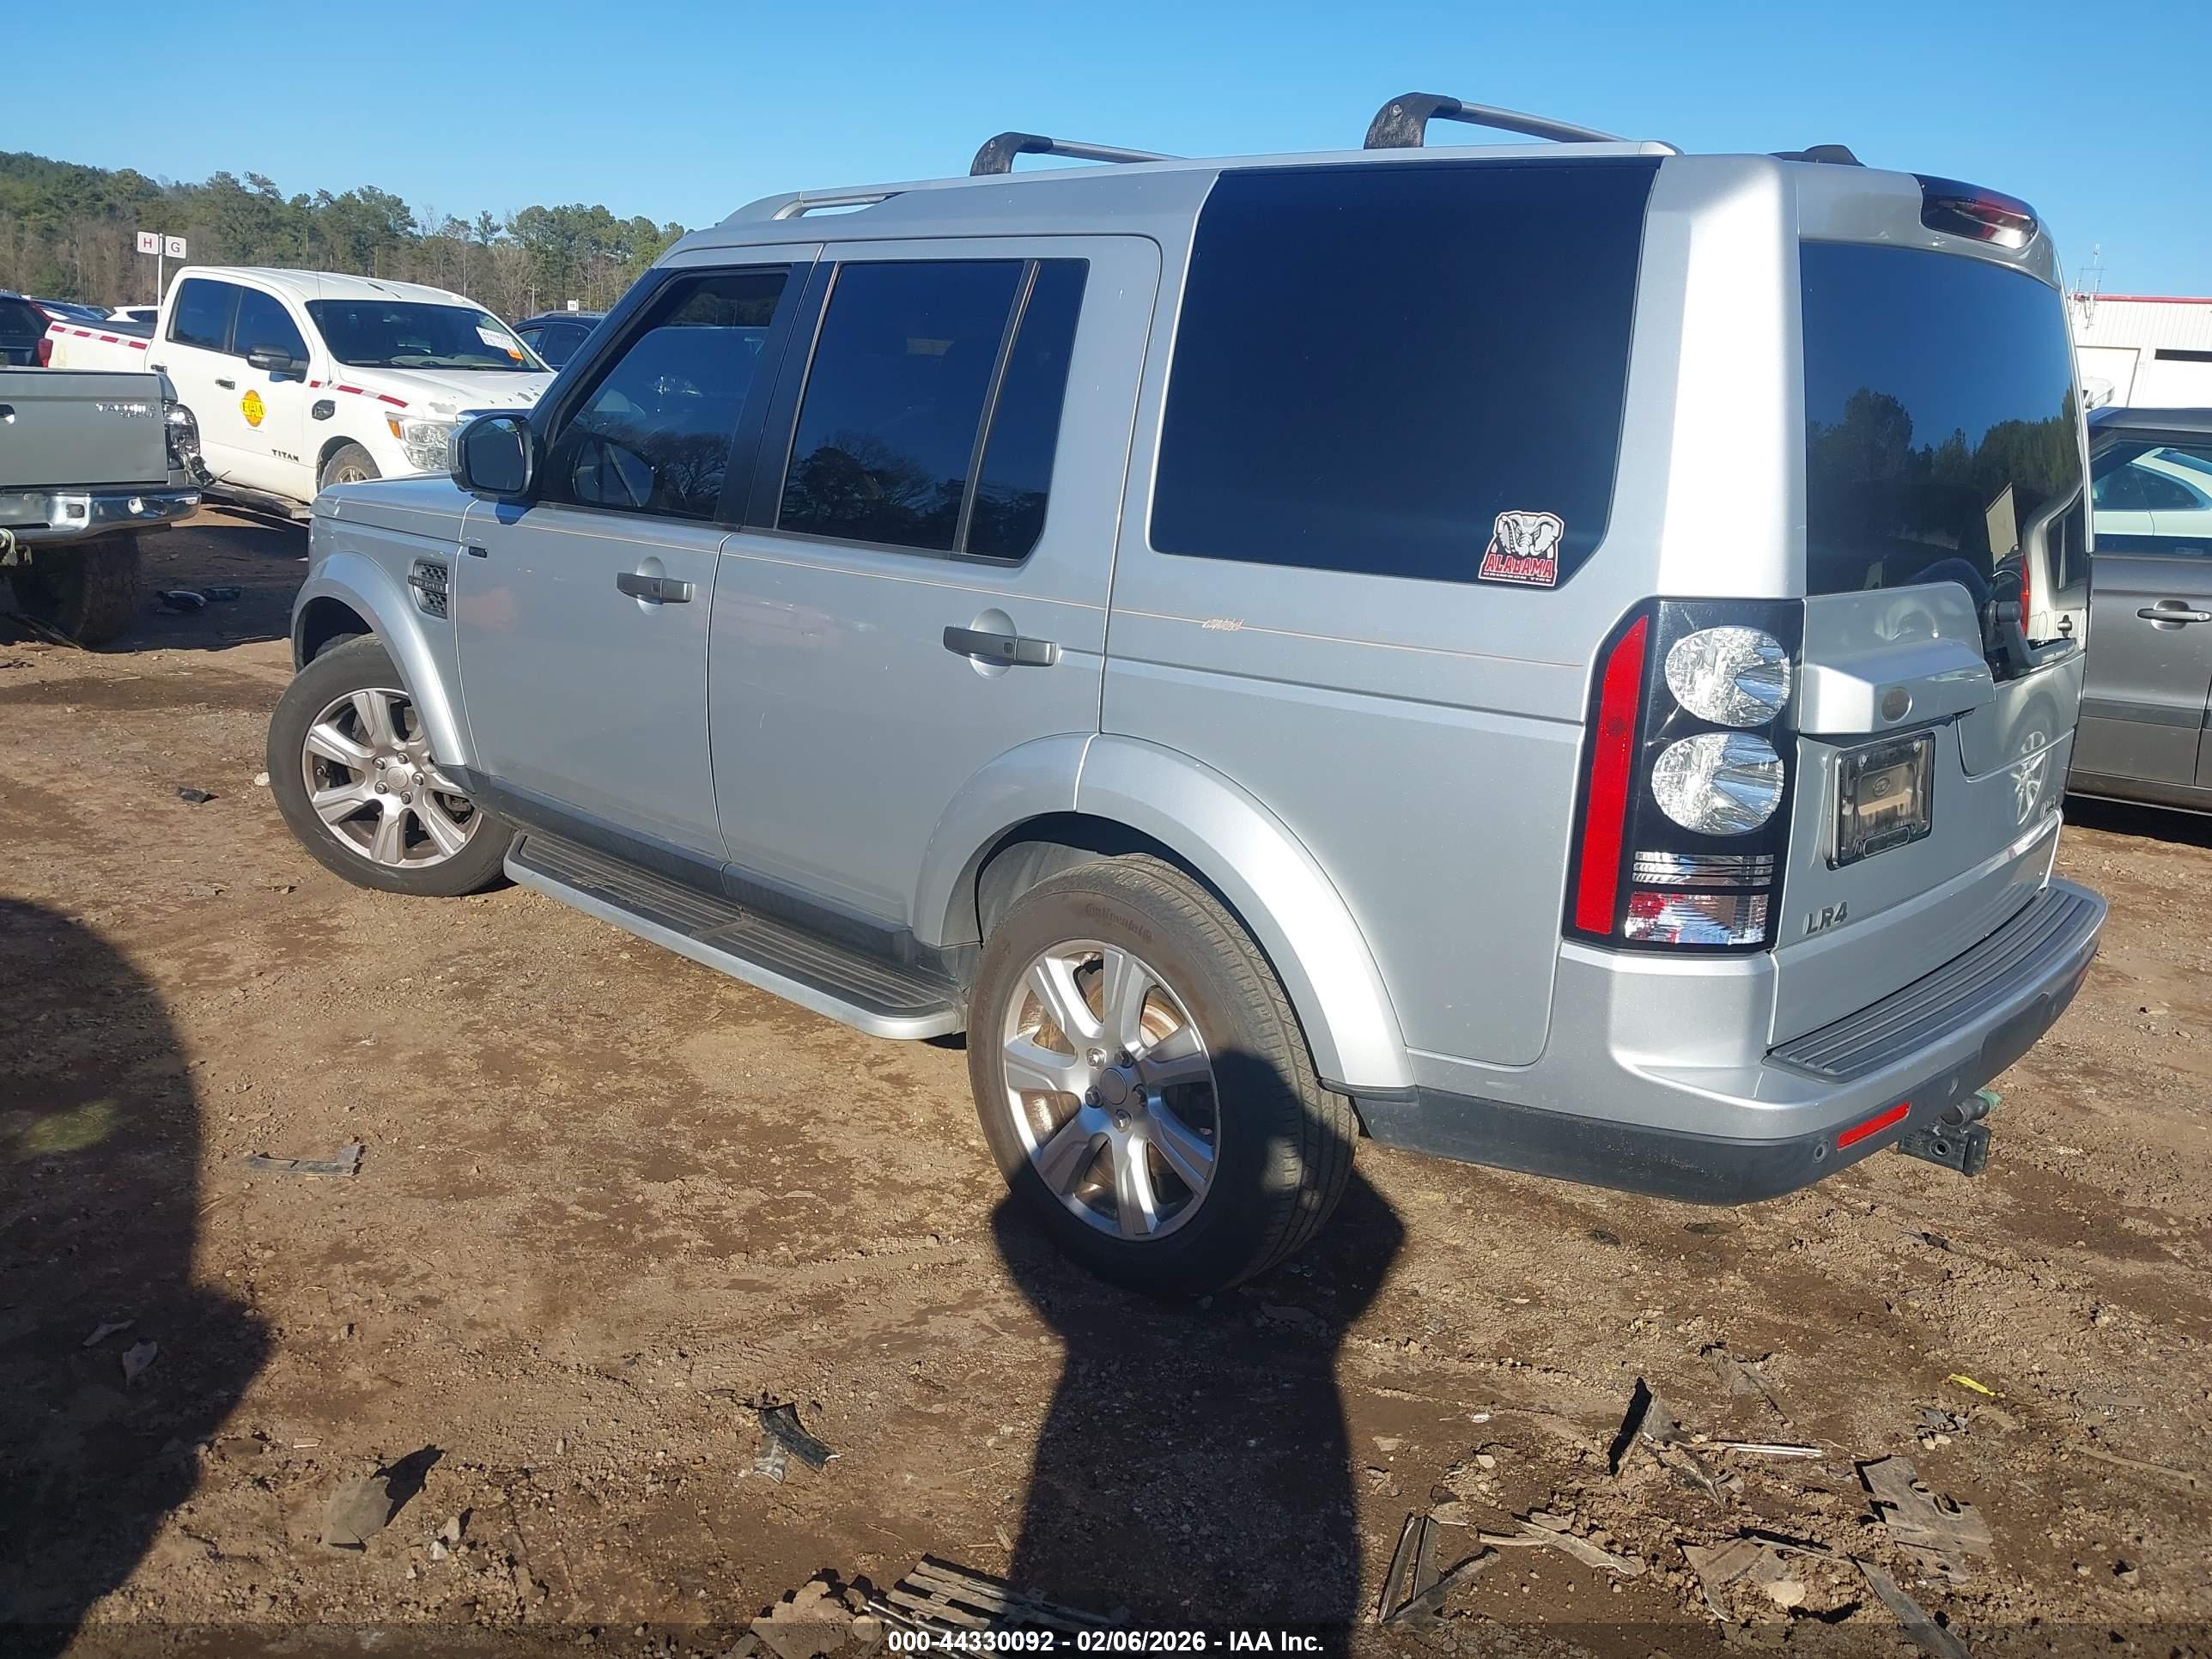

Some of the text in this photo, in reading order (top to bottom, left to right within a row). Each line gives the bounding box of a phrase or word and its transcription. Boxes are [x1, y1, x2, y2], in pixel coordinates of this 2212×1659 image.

[143, 237, 152, 248] H
[170, 241, 180, 252] G
[270, 448, 300, 462] TITAN
[1484, 553, 1553, 579] ALABAMA
[1085, 902, 1146, 937] Continental
[1802, 901, 1848, 935] LR4
